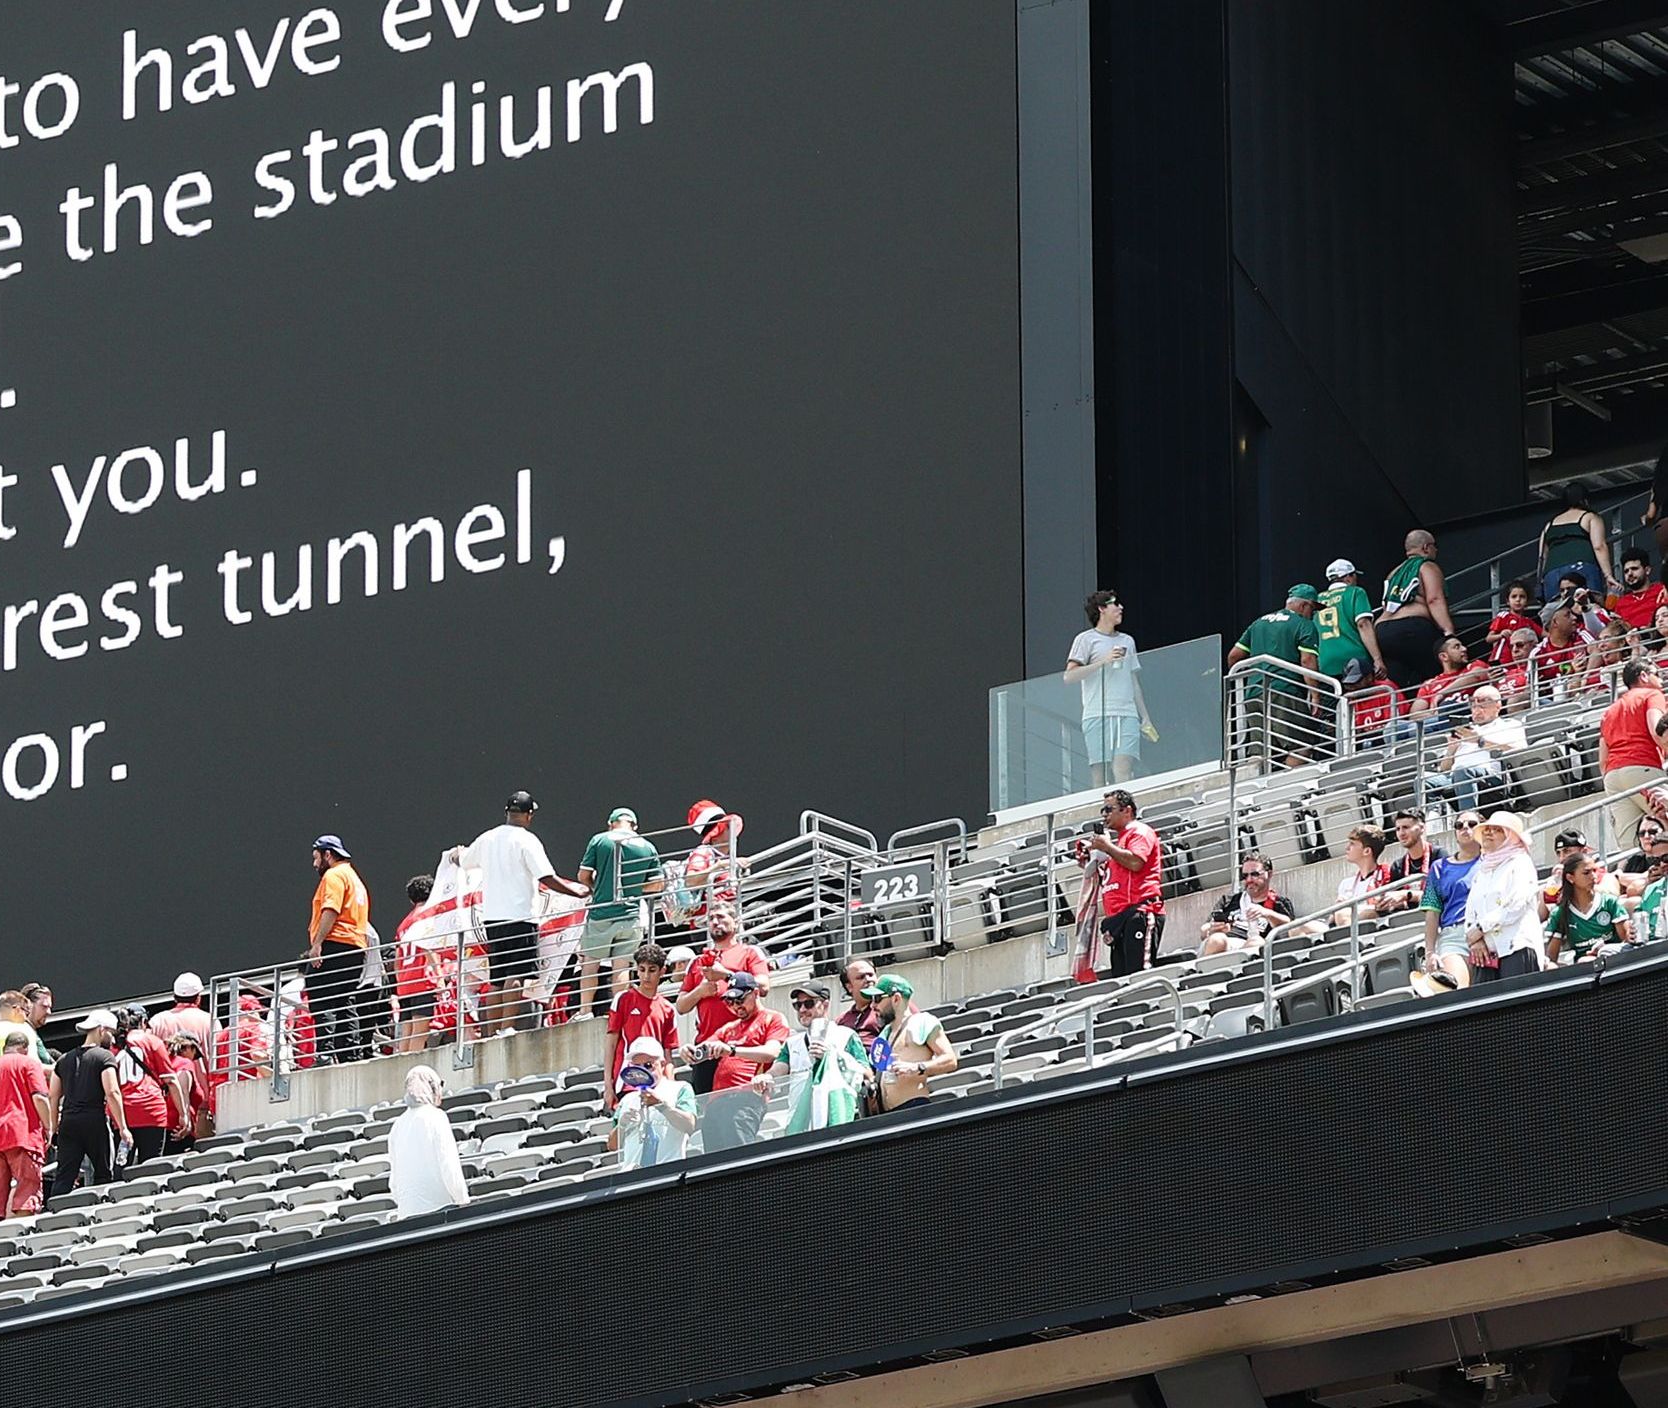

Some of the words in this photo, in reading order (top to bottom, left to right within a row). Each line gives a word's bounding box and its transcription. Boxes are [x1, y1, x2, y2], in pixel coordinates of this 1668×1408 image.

[122, 7, 341, 121] have
[381, 0, 625, 54] eve
[59, 162, 213, 262] the
[253, 61, 654, 219] stadium
[50, 429, 257, 549] you.
[217, 468, 565, 625] tunnel,
[1319, 609, 1342, 640] 9
[873, 873, 921, 904] 223
[118, 1046, 145, 1084] 10
